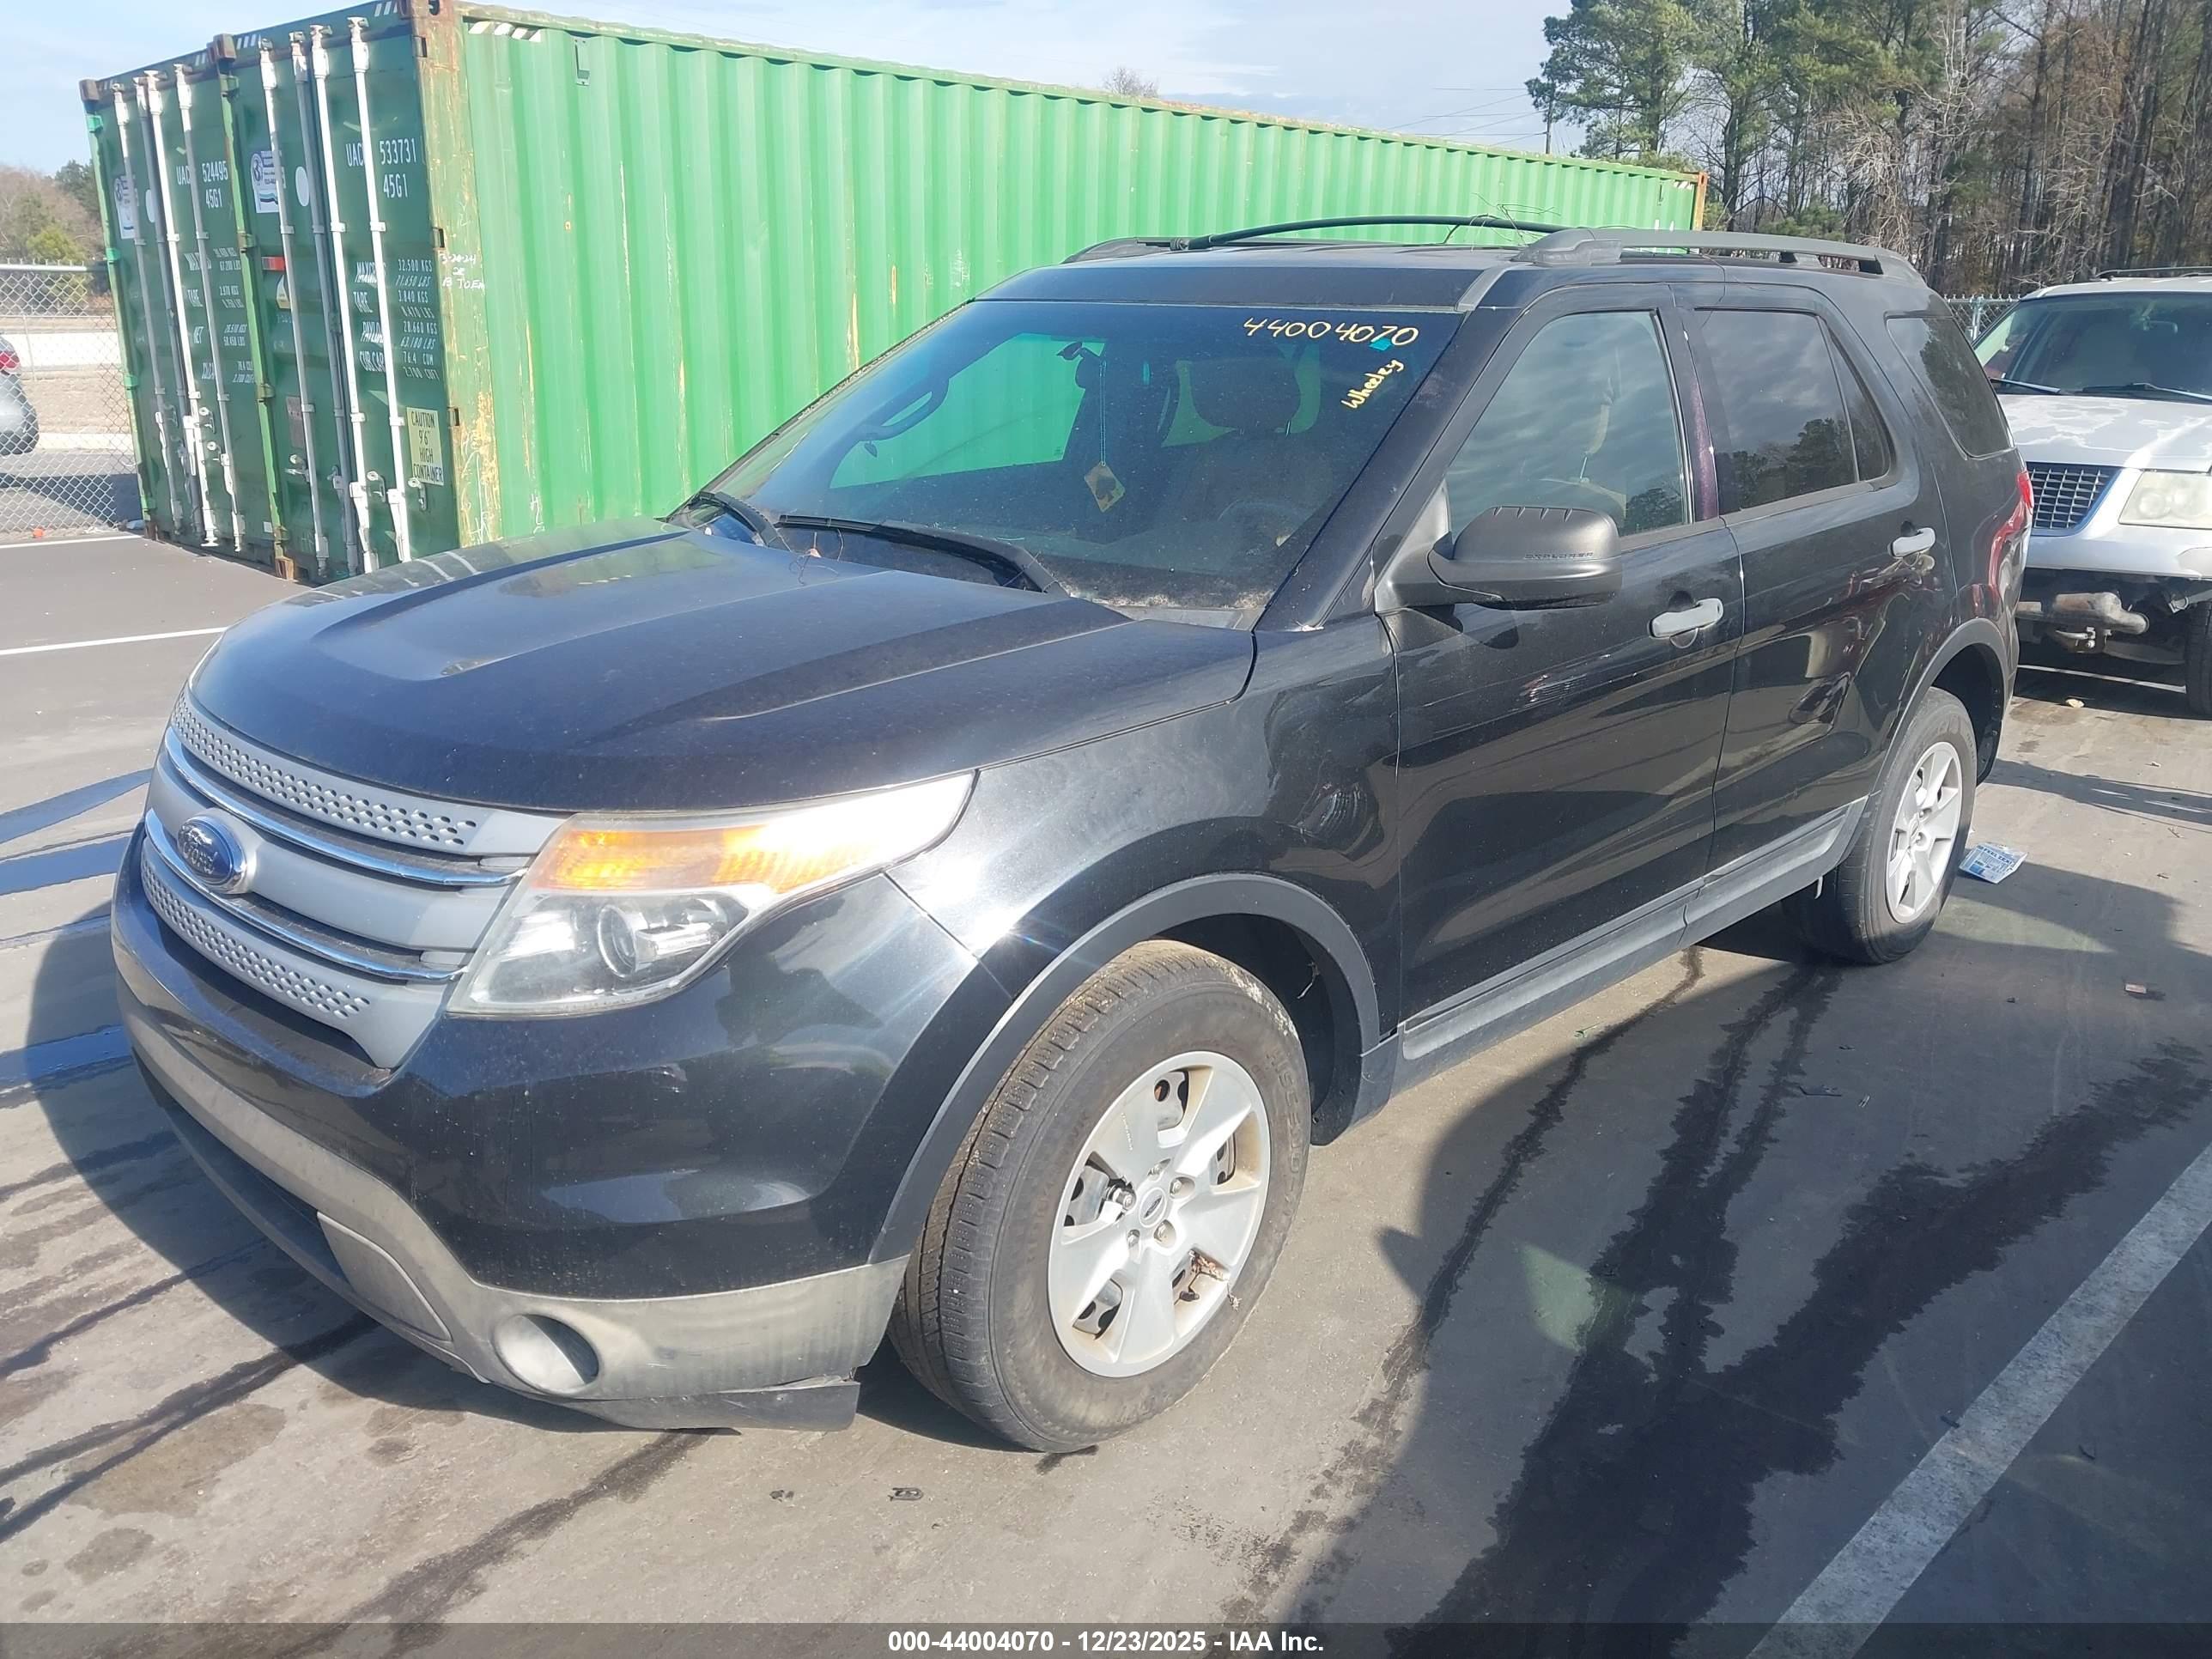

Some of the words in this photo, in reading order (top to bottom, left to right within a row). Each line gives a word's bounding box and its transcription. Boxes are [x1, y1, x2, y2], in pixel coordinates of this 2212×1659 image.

[380, 137, 416, 165] 533731
[202, 161, 228, 182] 524495
[384, 173, 408, 198] 45G1
[206, 188, 222, 209] 45G1
[421, 259, 433, 272] KGS
[417, 276, 431, 287] LBS
[353, 291, 374, 313] TARE
[417, 290, 428, 303] KGS
[426, 322, 438, 335] KGS
[1243, 317, 1419, 346] 44004070
[422, 337, 436, 349] LBS
[411, 411, 435, 428] CAUTION
[419, 447, 434, 464] HIGH
[413, 463, 444, 483] CONTAINER
